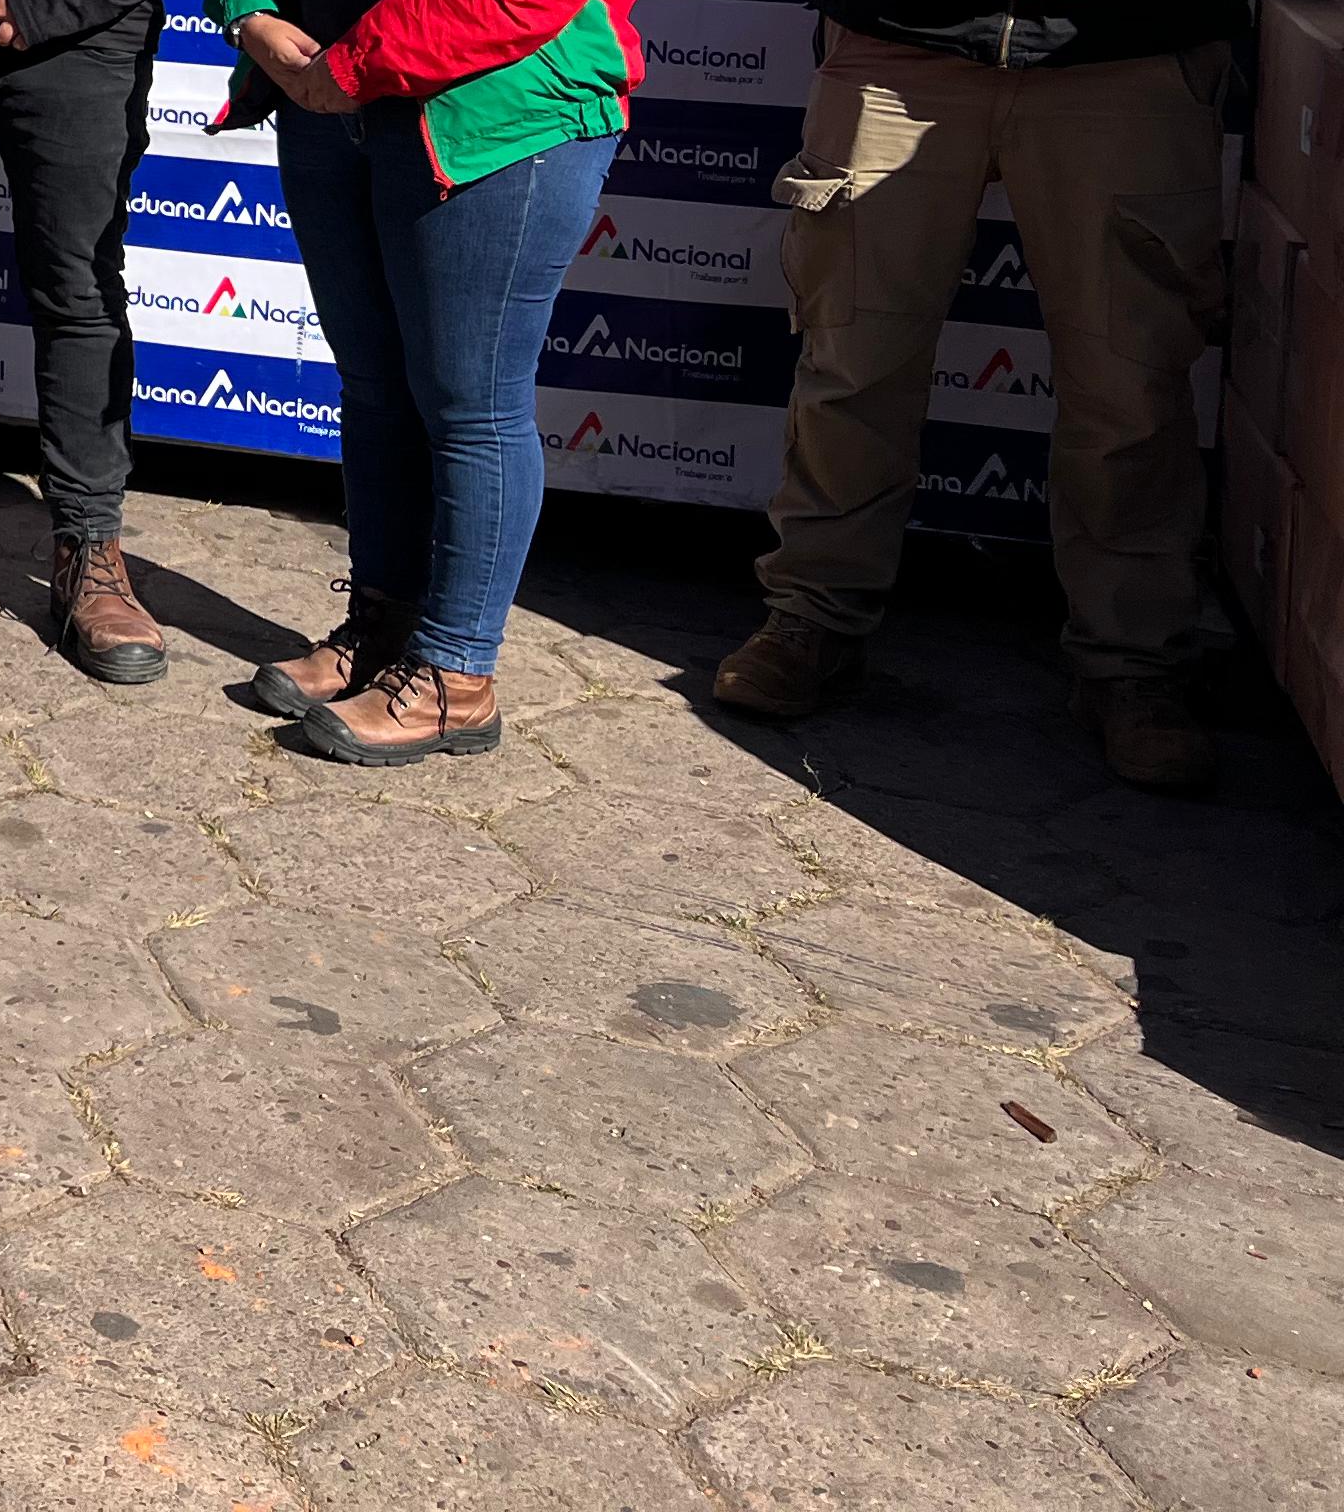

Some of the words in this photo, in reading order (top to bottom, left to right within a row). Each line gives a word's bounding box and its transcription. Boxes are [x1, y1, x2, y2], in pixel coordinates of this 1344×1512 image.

[640, 141, 758, 169] Nacional
[128, 286, 199, 312] duana
[626, 338, 742, 368] Nacional
